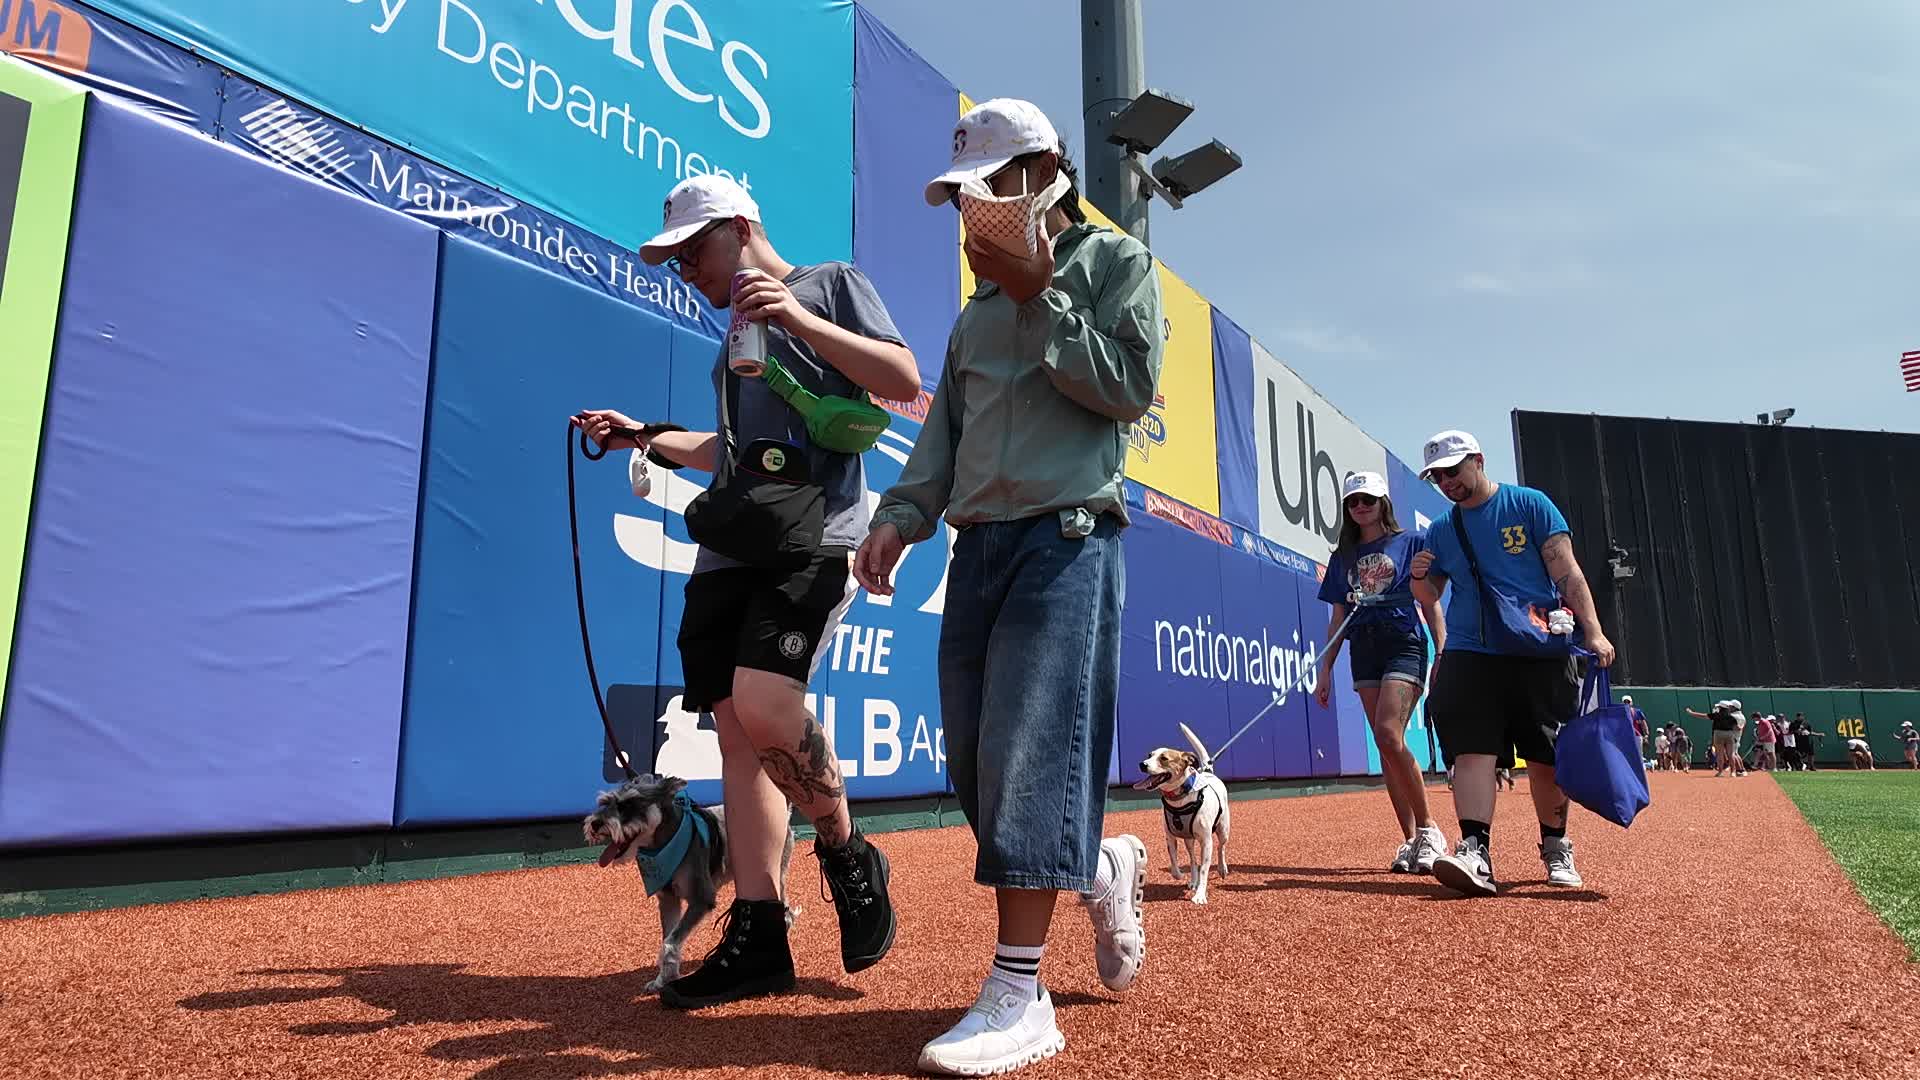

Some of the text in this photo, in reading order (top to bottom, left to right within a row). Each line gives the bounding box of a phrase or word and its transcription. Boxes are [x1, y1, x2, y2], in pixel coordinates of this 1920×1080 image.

[368, 149, 701, 321] Maimonides Health
[1140, 414, 1161, 437] 1920
[1267, 377, 1342, 545] Ub
[1501, 525, 1528, 548] 33
[831, 623, 894, 675] THE
[908, 714, 947, 774] Ap
[1837, 718, 1866, 738] 412
